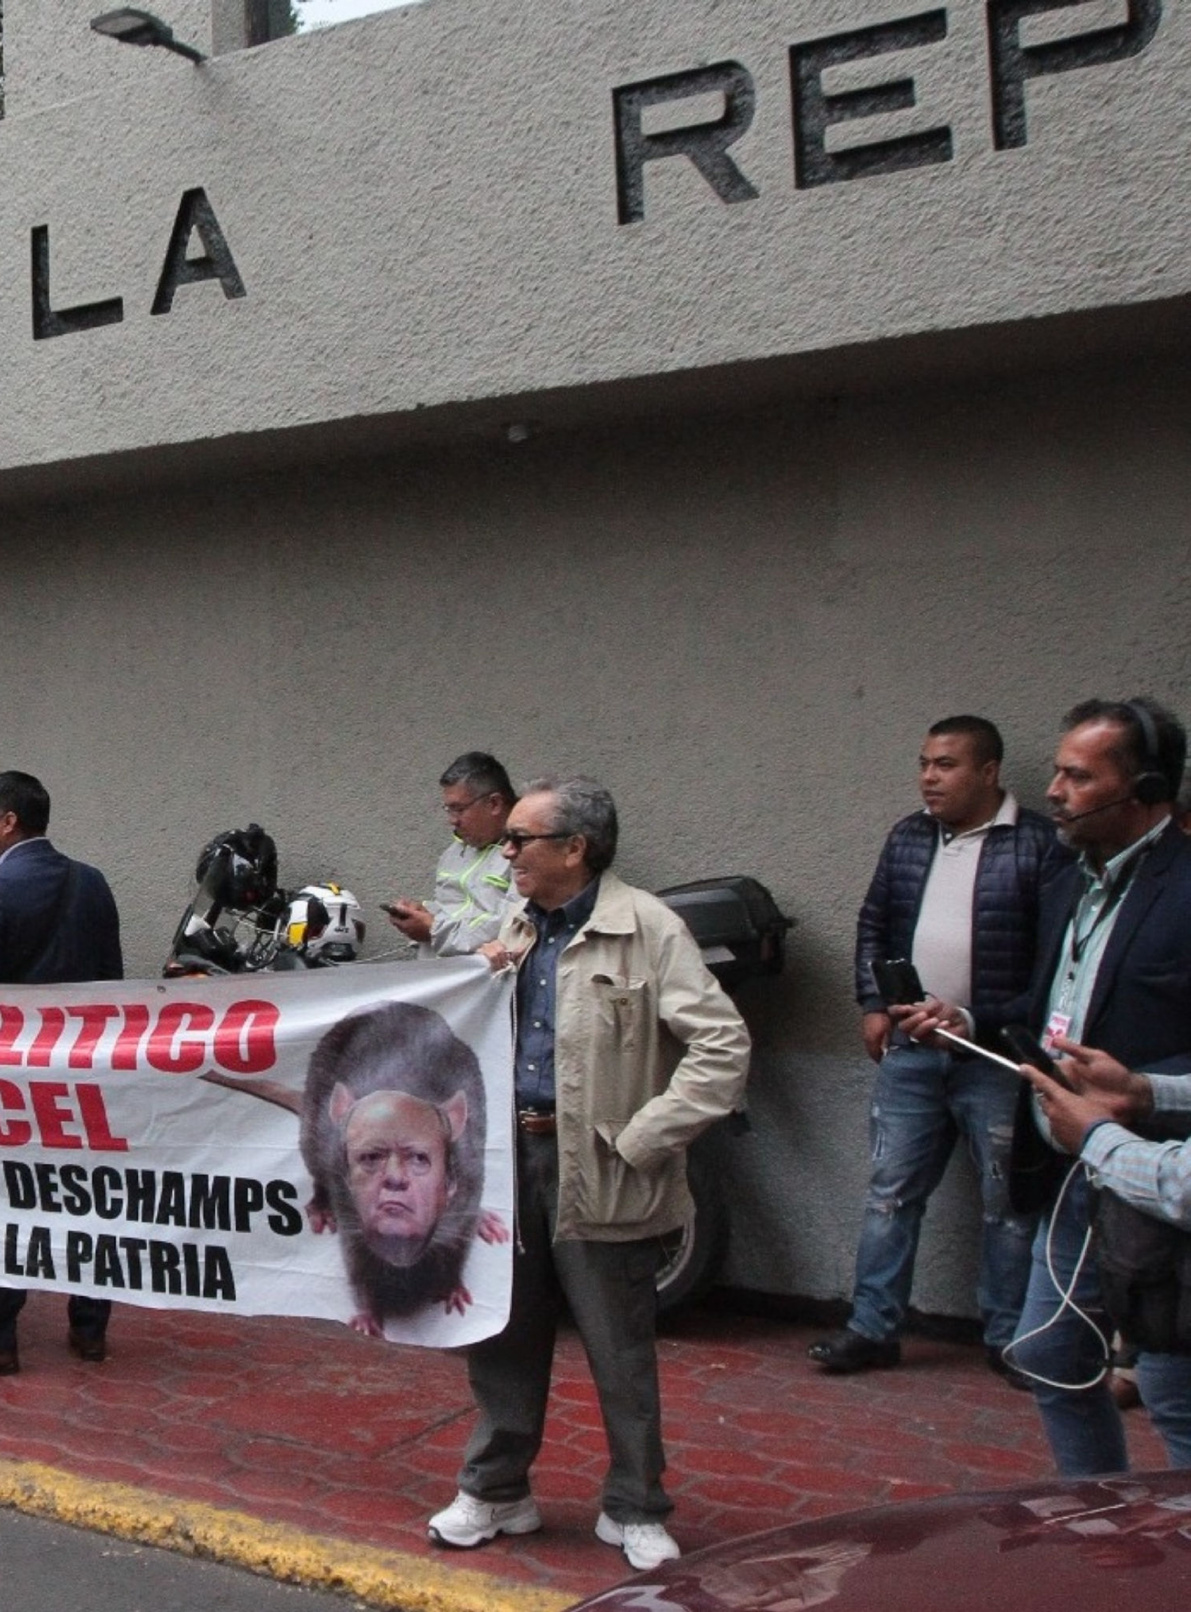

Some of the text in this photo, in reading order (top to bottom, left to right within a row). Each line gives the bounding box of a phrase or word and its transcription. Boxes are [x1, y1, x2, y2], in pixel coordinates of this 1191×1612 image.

[31, 186, 247, 341] LA
[612, 0, 1164, 225] REP
[3, 1160, 303, 1237] DESCHAMPS
[4, 1223, 57, 1280] LA
[67, 1230, 237, 1302] PATRIA
